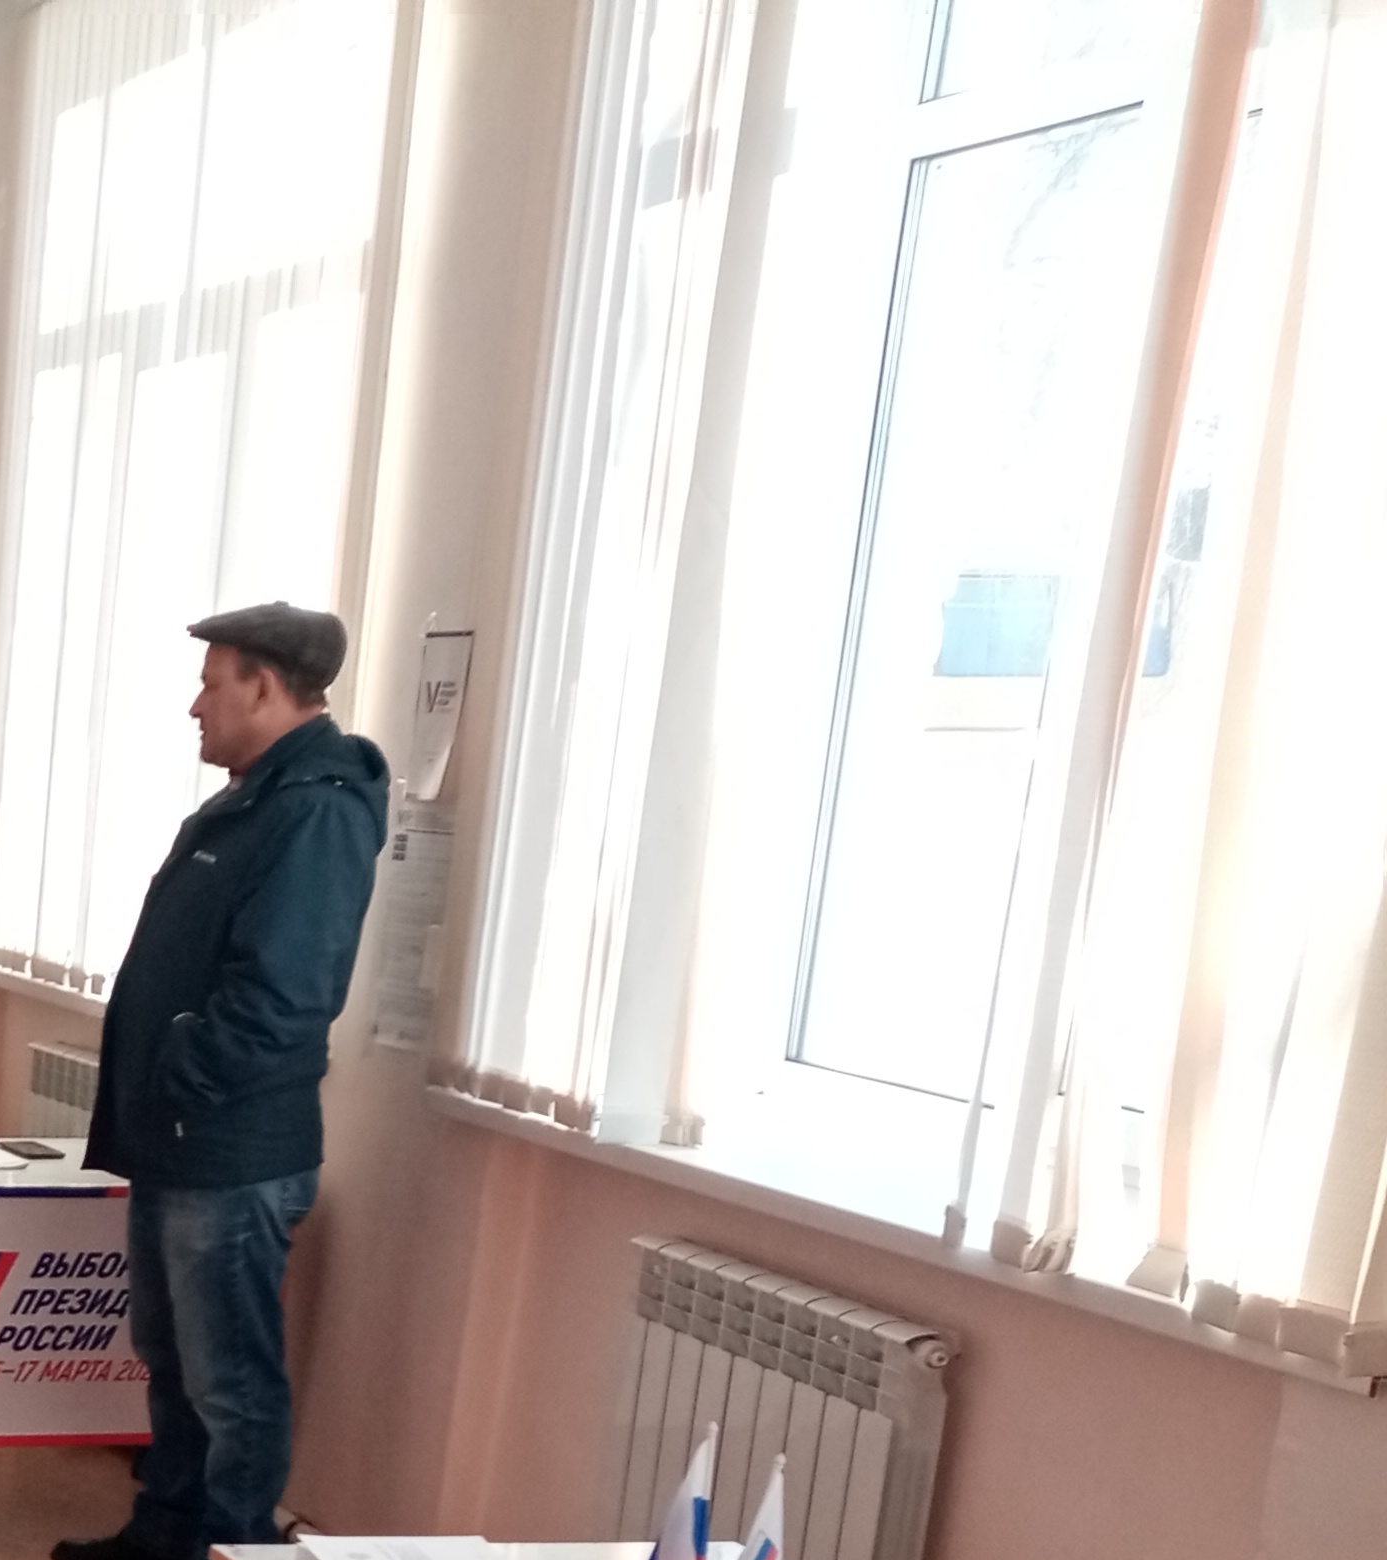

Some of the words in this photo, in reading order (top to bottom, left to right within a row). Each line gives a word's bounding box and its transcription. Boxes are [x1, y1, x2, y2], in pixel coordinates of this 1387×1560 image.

[30, 1251, 130, 1279] ВЫБО
[10, 1288, 130, 1319] ПРЕЗИД
[38, 1360, 113, 1382] МАРТА
[113, 1359, 151, 1382] 202
